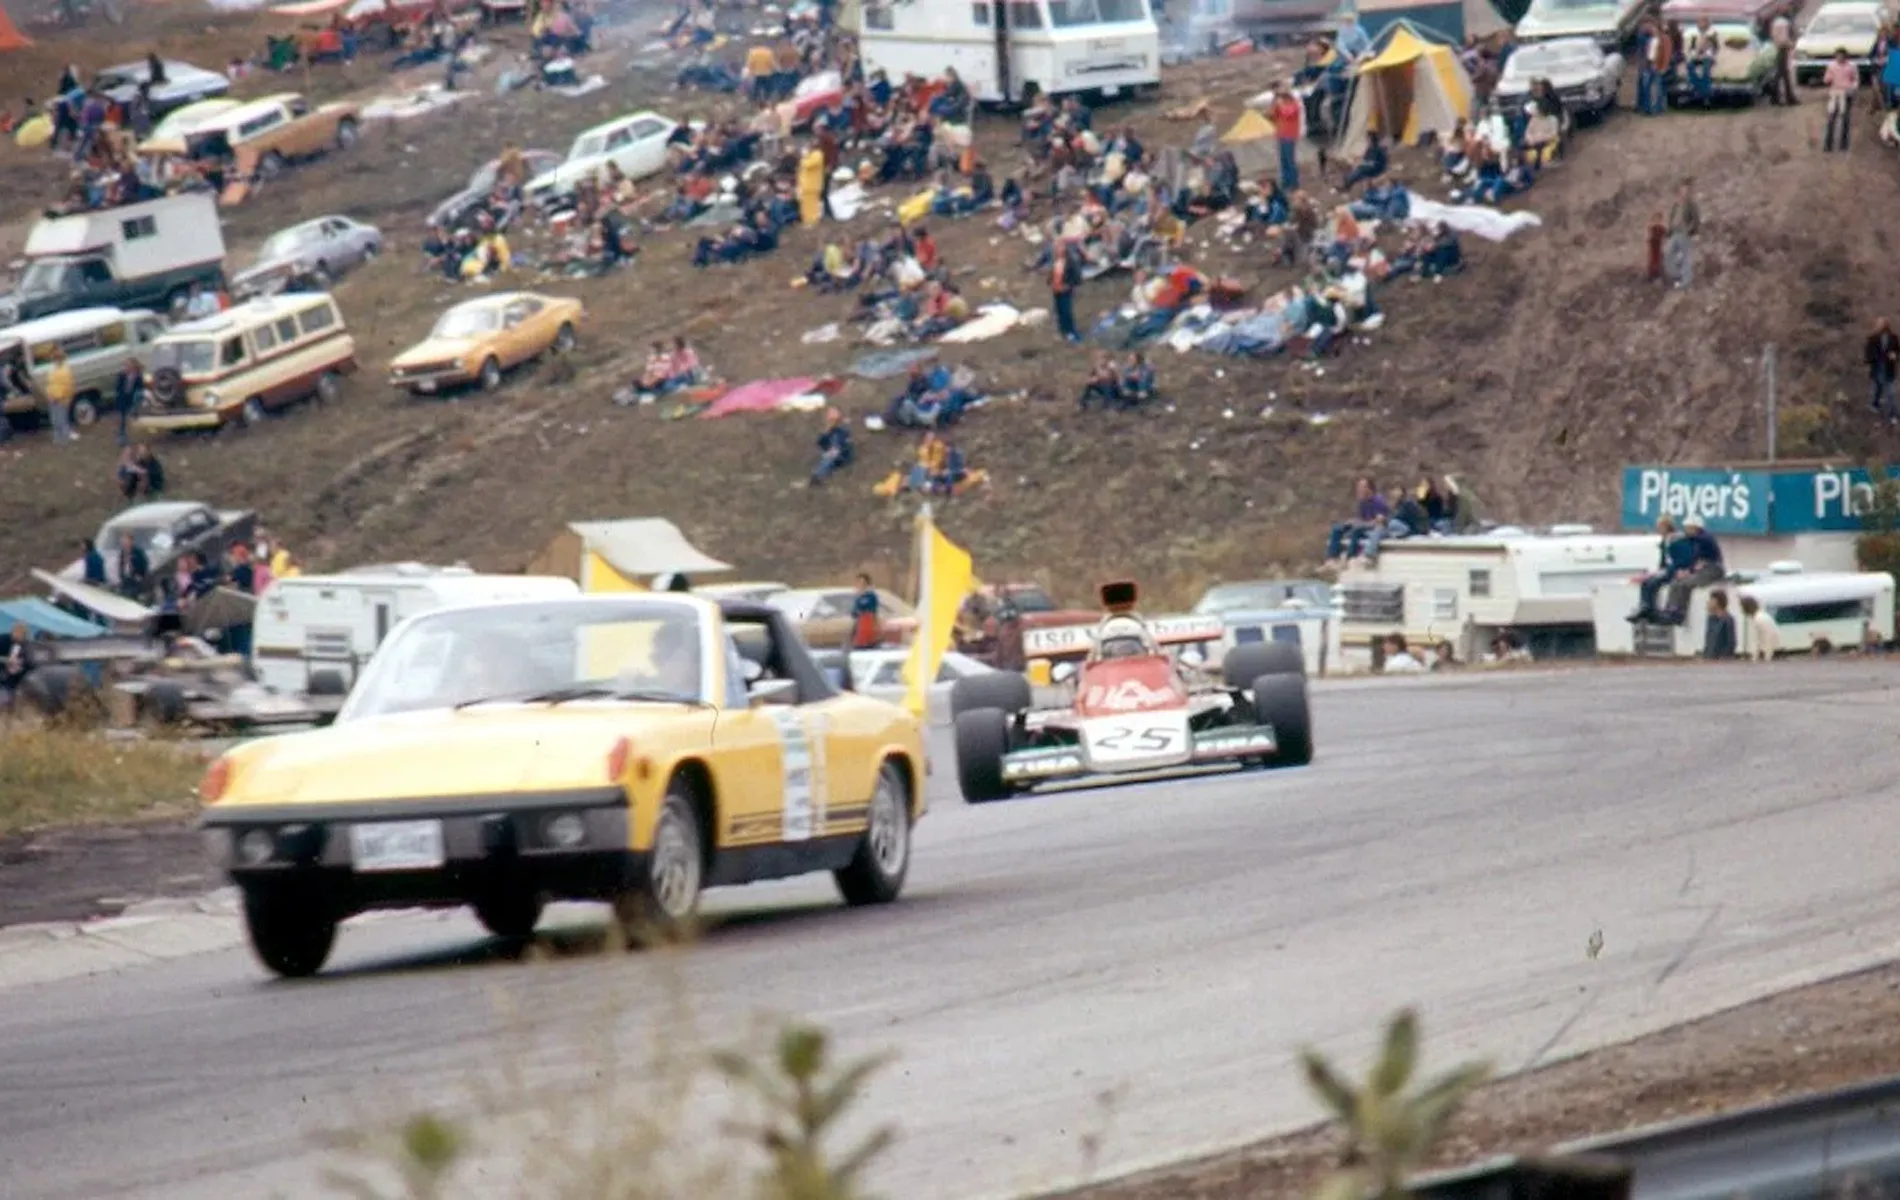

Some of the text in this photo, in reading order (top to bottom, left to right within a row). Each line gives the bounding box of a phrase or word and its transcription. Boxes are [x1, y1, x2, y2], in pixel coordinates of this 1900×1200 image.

[1640, 469, 1749, 519] Player's
[1034, 631, 1075, 648] ISO
[1095, 726, 1181, 752] 25
